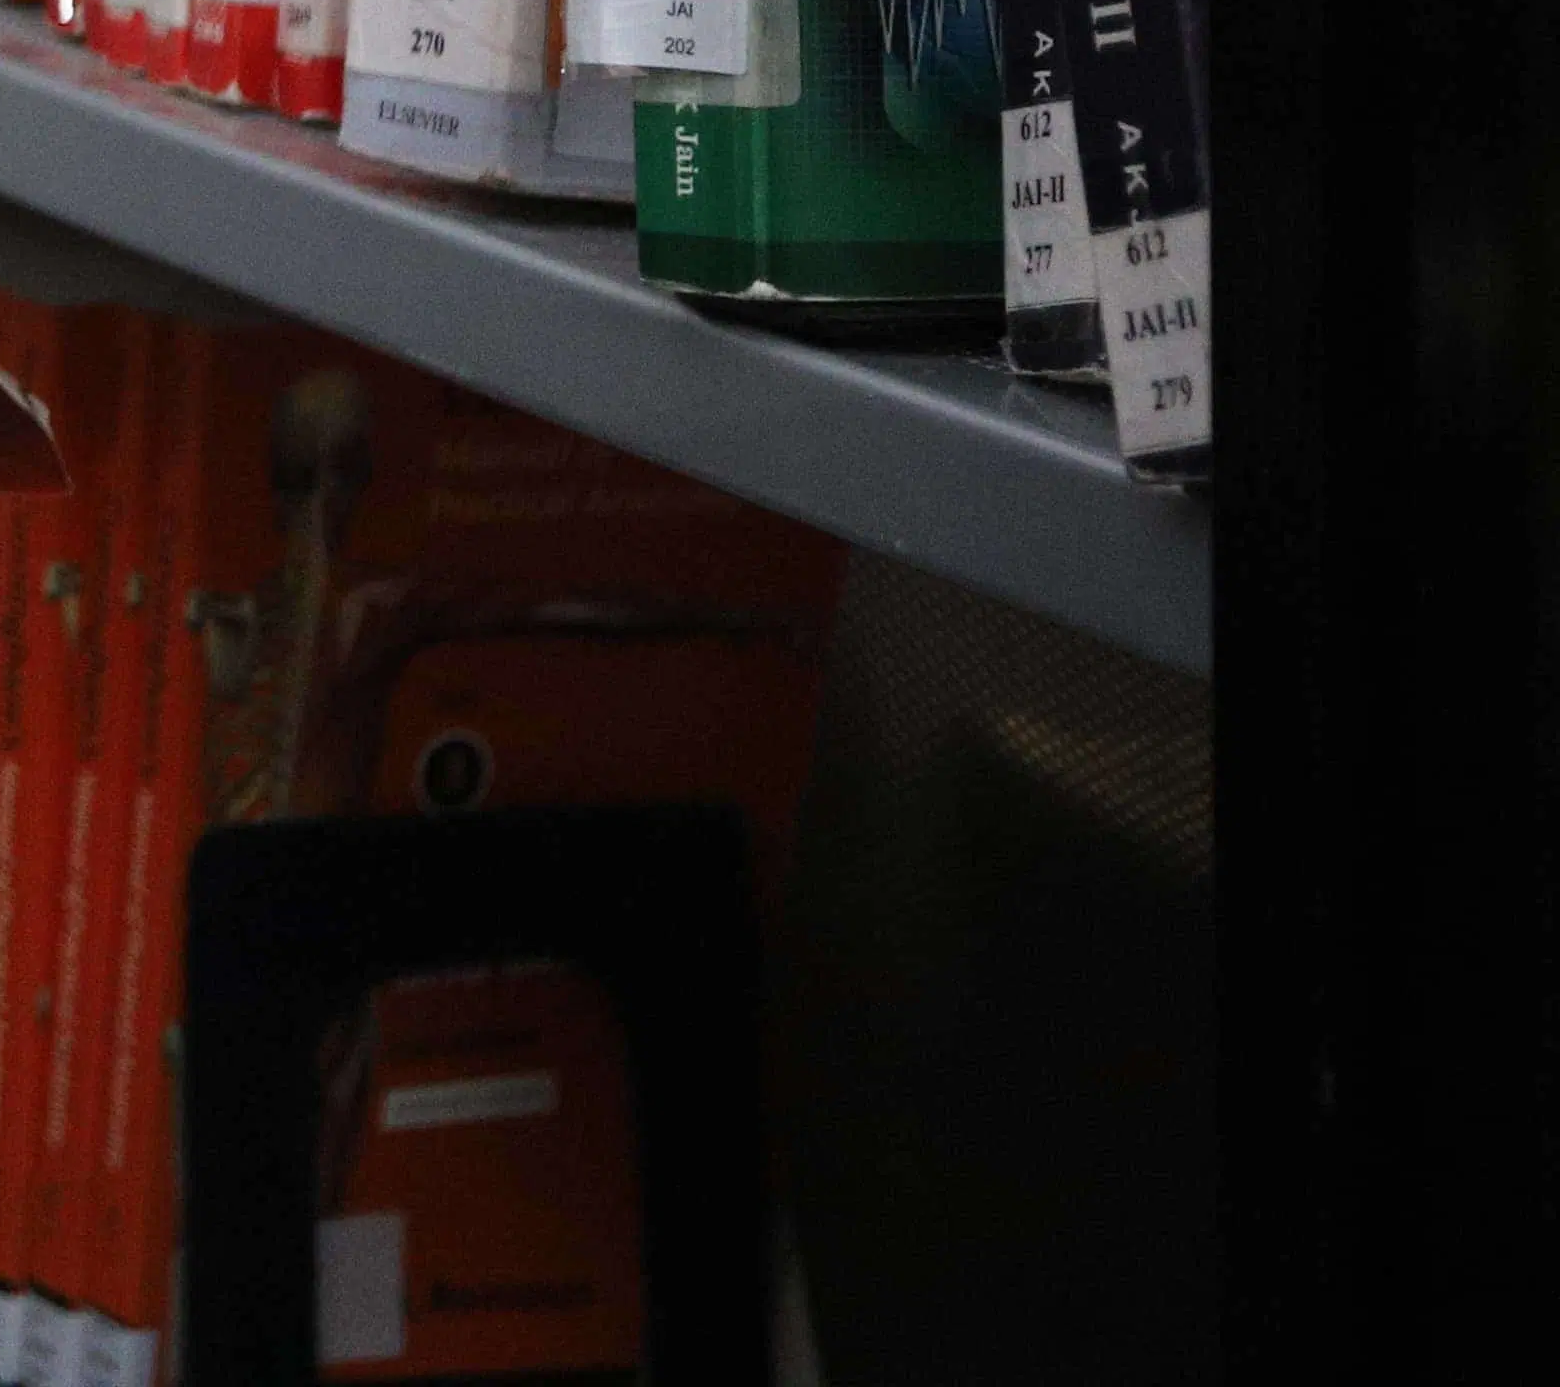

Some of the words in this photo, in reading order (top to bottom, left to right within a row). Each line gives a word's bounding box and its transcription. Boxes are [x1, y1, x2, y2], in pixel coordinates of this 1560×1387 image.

[666, 1, 693, 20] JAI
[410, 29, 445, 57] 270
[663, 36, 696, 57] 202
[1033, 30, 1055, 58] A
[1031, 68, 1053, 96] K
[378, 100, 461, 137] ELSEVIER
[1020, 111, 1054, 142] 612
[1119, 121, 1142, 153] A
[675, 125, 698, 197] Jain
[1012, 173, 1067, 210] JAI-II
[1124, 165, 1150, 194] K
[1023, 244, 1055, 275] 277
[1125, 229, 1170, 267] 612
[1123, 297, 1200, 342] JAI-II
[1151, 380, 1194, 412] 279
